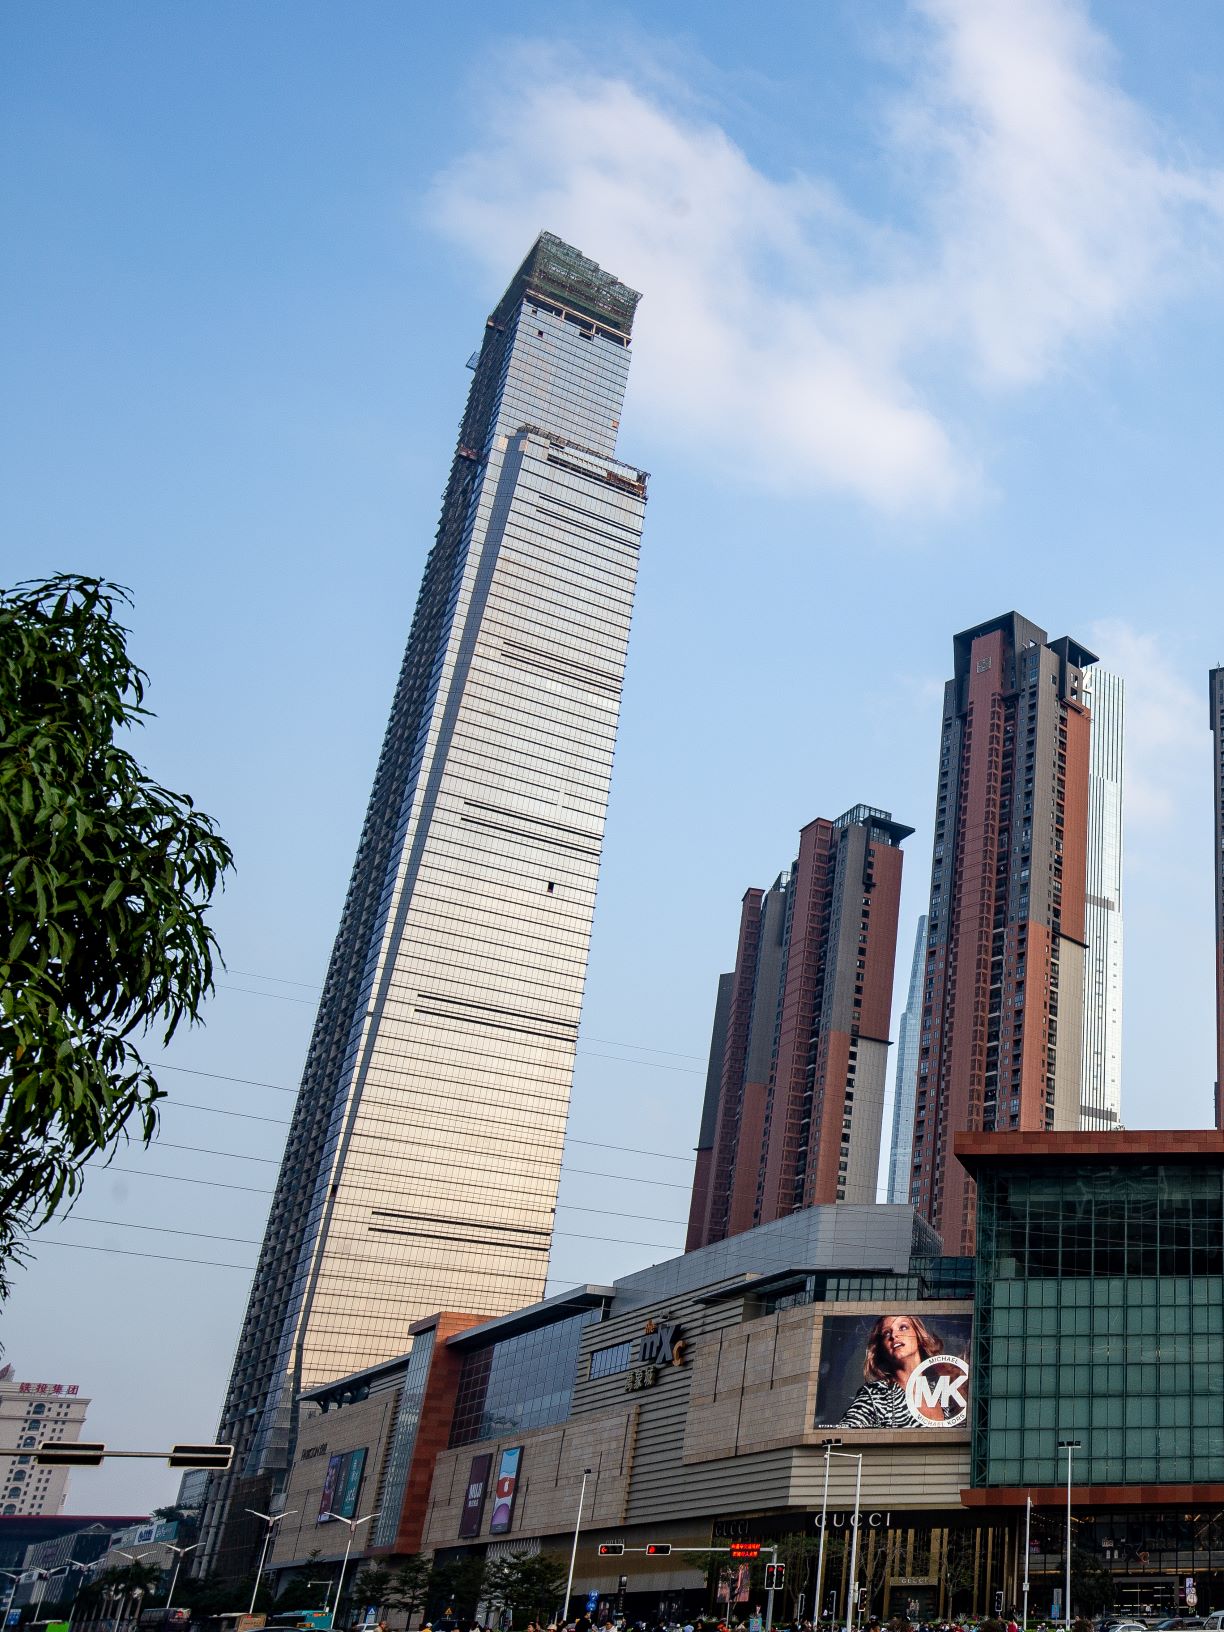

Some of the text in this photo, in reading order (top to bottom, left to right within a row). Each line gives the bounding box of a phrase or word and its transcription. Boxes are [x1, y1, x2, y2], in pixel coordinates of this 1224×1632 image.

[928, 1356, 959, 1365] MICHAEL
[19, 1382, 80, 1395] 铁投集团
[914, 1375, 968, 1408] MK
[916, 1413, 966, 1427] MICHAEL KORS
[814, 1512, 891, 1528] GUCCI
[715, 1519, 749, 1537] GUCCI
